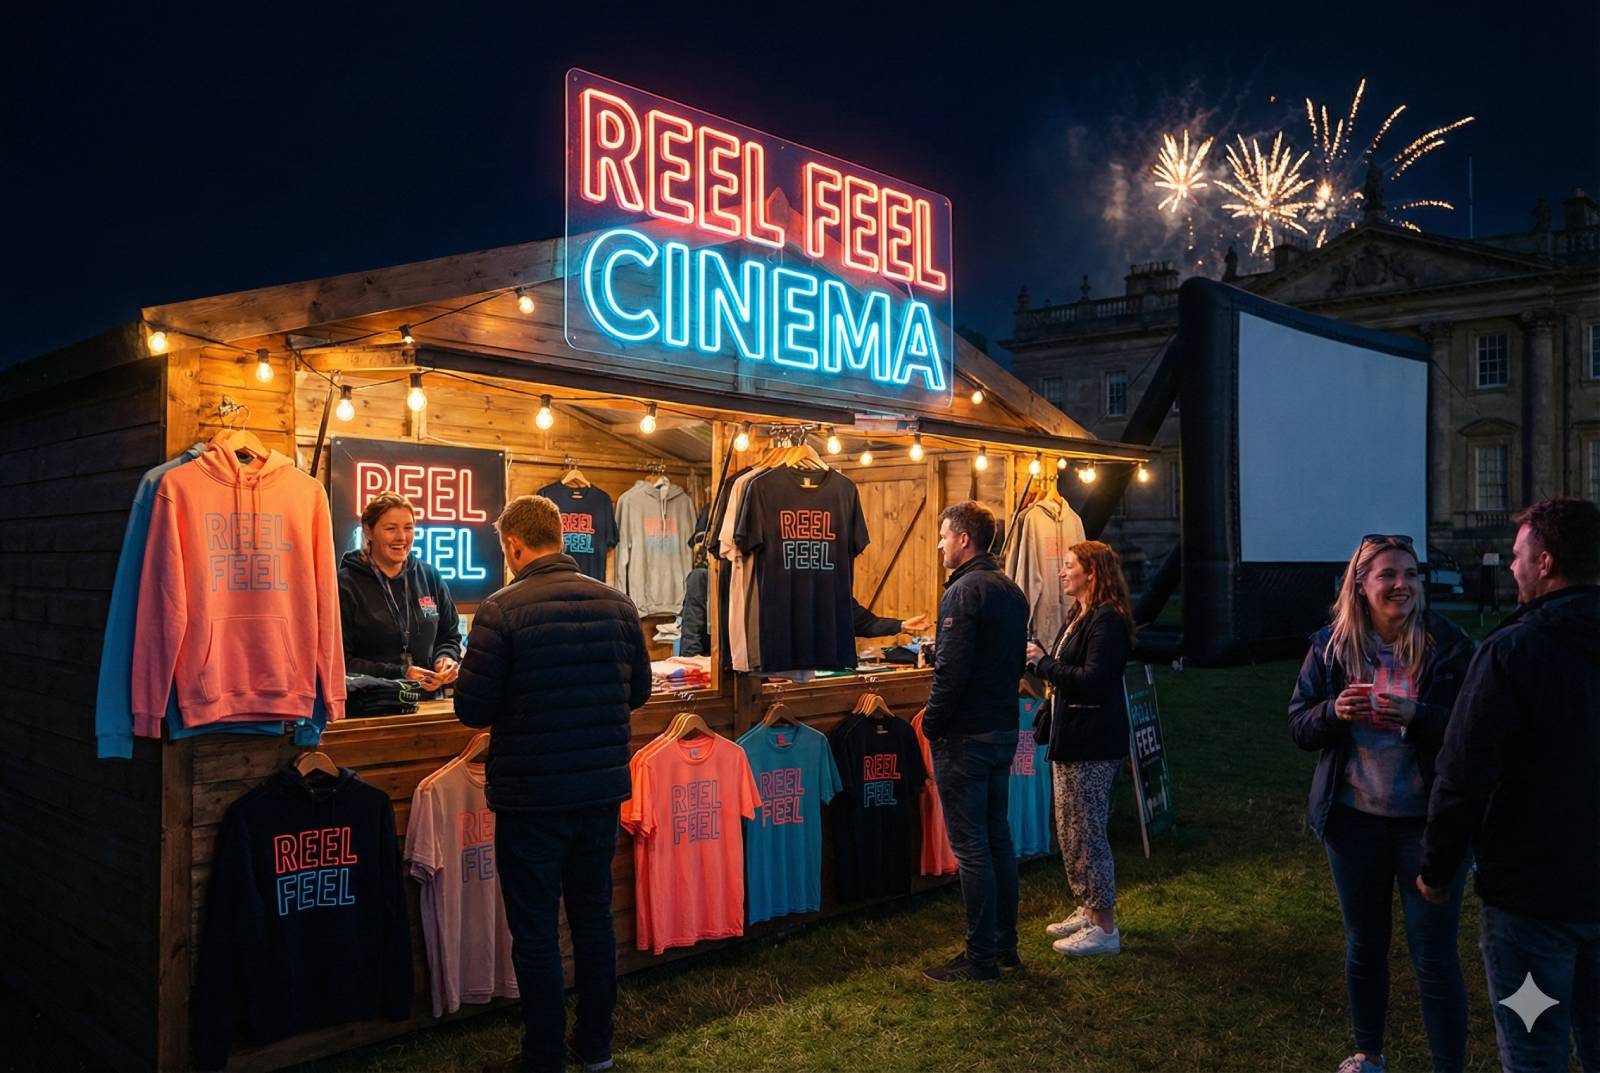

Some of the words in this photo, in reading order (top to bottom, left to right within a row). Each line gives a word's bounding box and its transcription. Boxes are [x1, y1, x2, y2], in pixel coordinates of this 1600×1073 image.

[580, 88, 785, 248] REEL
[804, 161, 947, 291] FEEL
[581, 228, 947, 391] CINEMA
[204, 512, 293, 553] REEL
[780, 510, 836, 540] REEL
[783, 541, 834, 570] FEEL
[209, 554, 289, 592] FEEL
[1135, 725, 1161, 758] FEEL
[760, 768, 805, 799] REEL
[864, 754, 901, 780] REEL
[672, 780, 722, 813] REEL
[864, 780, 897, 808] FEEL
[672, 811, 720, 845] FEEL
[762, 796, 804, 830] FEEL
[274, 827, 358, 874] REEL
[276, 868, 356, 916] FEEL
